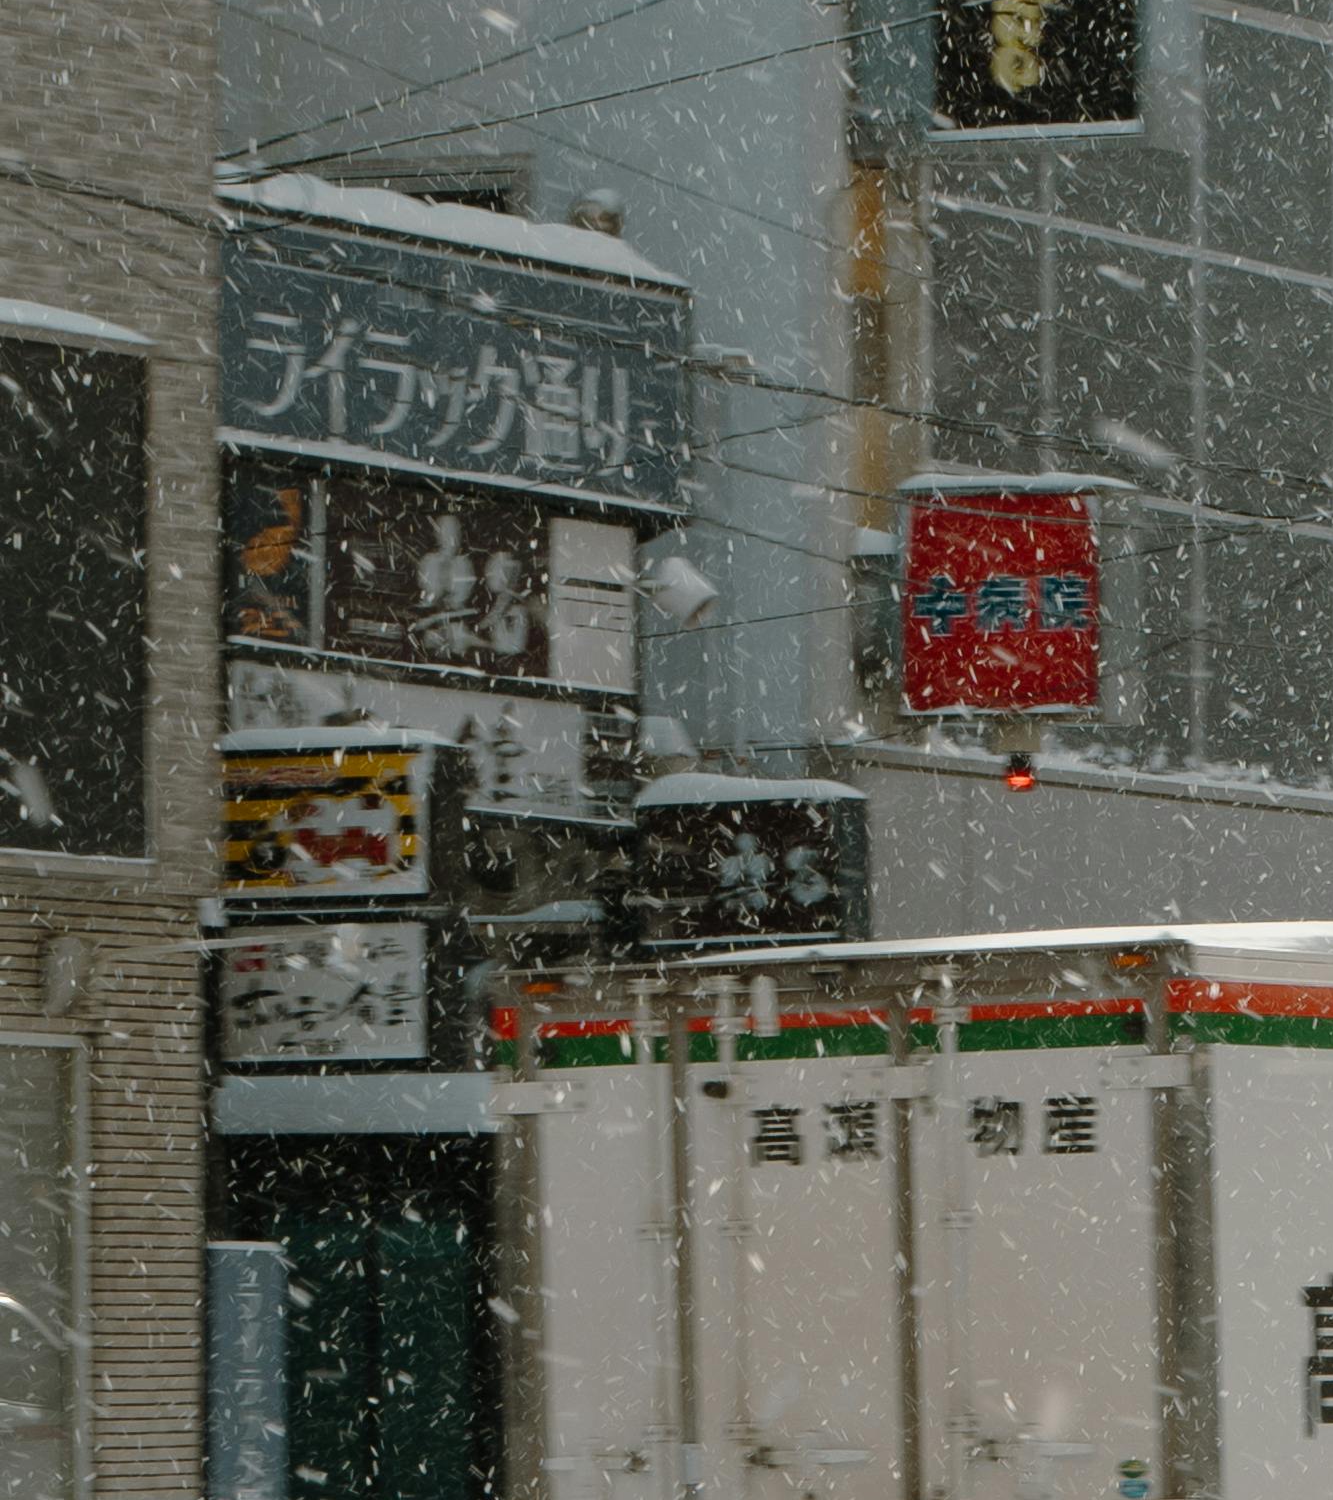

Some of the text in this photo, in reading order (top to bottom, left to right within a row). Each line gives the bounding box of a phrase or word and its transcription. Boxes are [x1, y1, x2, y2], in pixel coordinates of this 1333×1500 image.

[240, 311, 631, 479] ライラック通り
